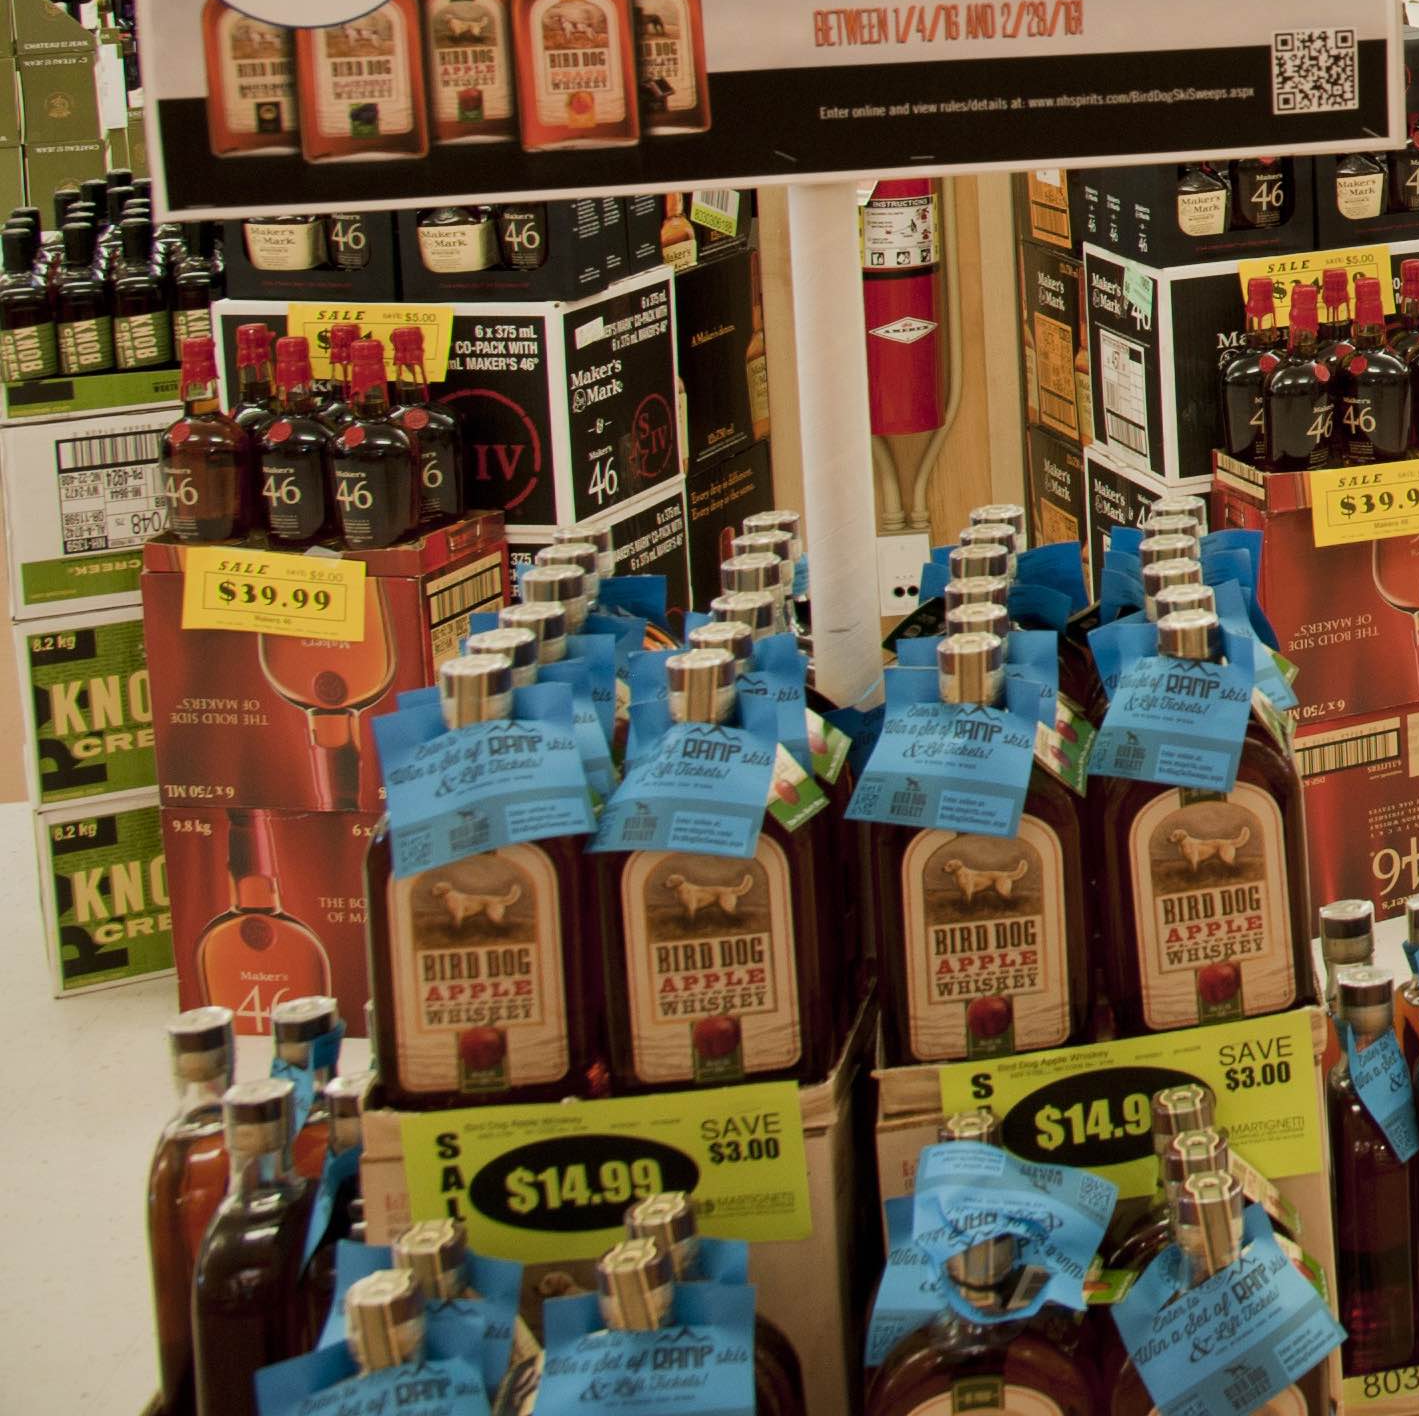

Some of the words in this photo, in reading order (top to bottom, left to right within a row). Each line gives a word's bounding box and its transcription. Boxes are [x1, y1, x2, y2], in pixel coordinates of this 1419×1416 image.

[813, 6, 889, 48] BETWEEN
[892, 4, 961, 45] 1/4/16
[966, 2, 995, 42] AND
[820, 105, 849, 119] Enter
[853, 104, 886, 117] online
[889, 103, 910, 116] and
[913, 102, 937, 115] view
[940, 98, 1008, 114] rules/details
[216, 580, 332, 611] $39.99
[1162, 894, 1215, 924] BIRD
[1219, 886, 1262, 915] DOG
[1166, 916, 1264, 944] APPLE
[1166, 938, 1264, 966] WHISKEY
[506, 1158, 663, 1213] $14.99
[701, 1112, 783, 1140] SAVE
[709, 1138, 781, 1165] $3.00
